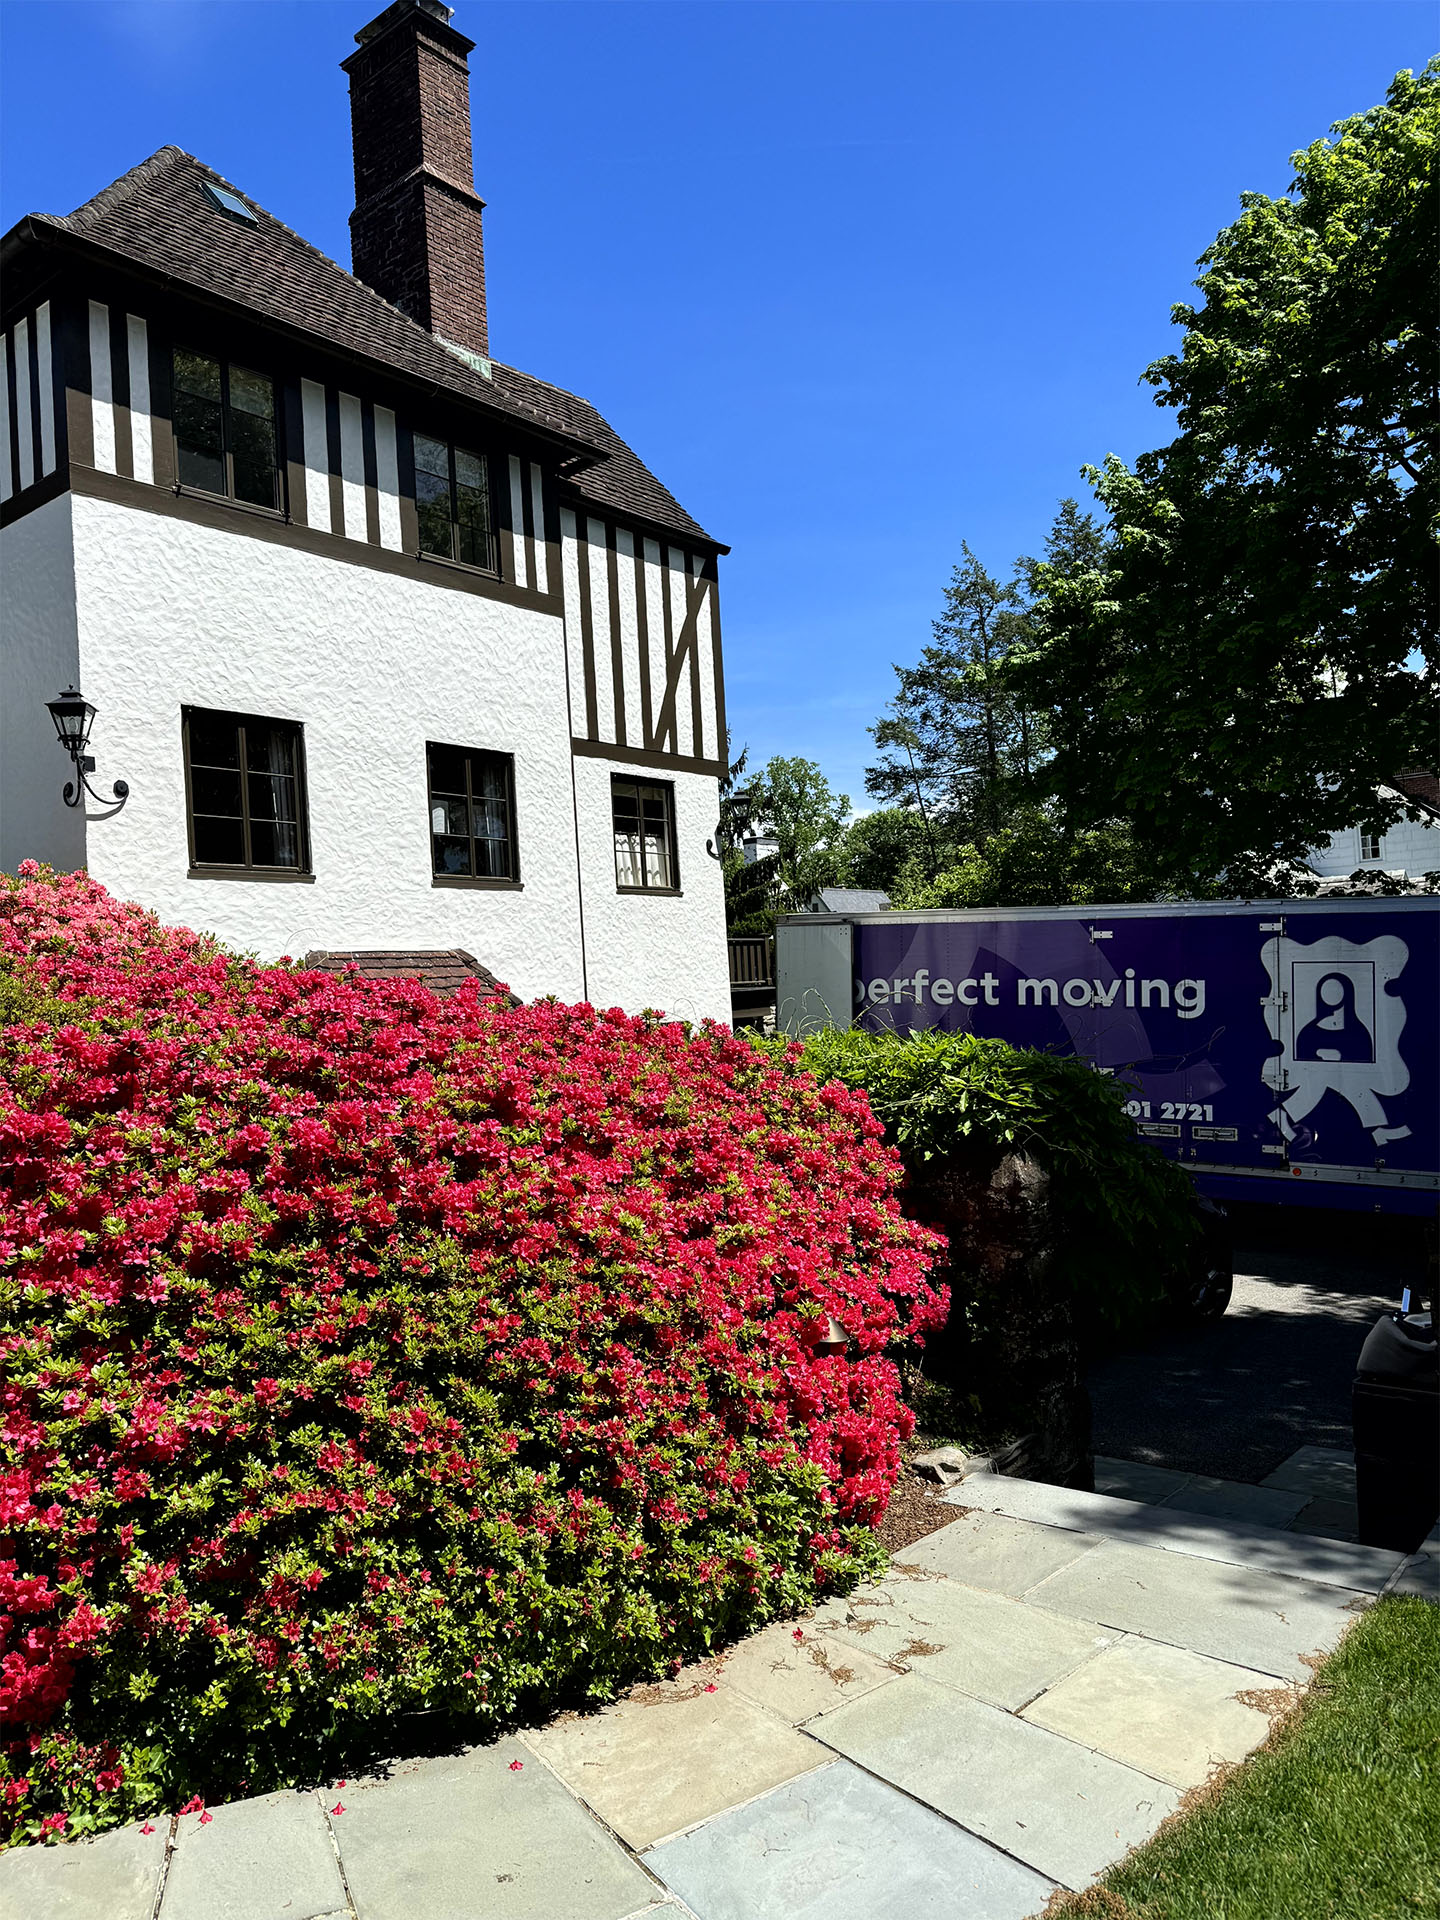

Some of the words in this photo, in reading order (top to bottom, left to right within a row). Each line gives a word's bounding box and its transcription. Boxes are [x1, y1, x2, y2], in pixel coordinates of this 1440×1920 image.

[1017, 968, 1206, 1019] moving
[1120, 1099, 1151, 1118] 01
[1160, 1101, 1214, 1122] 2721
